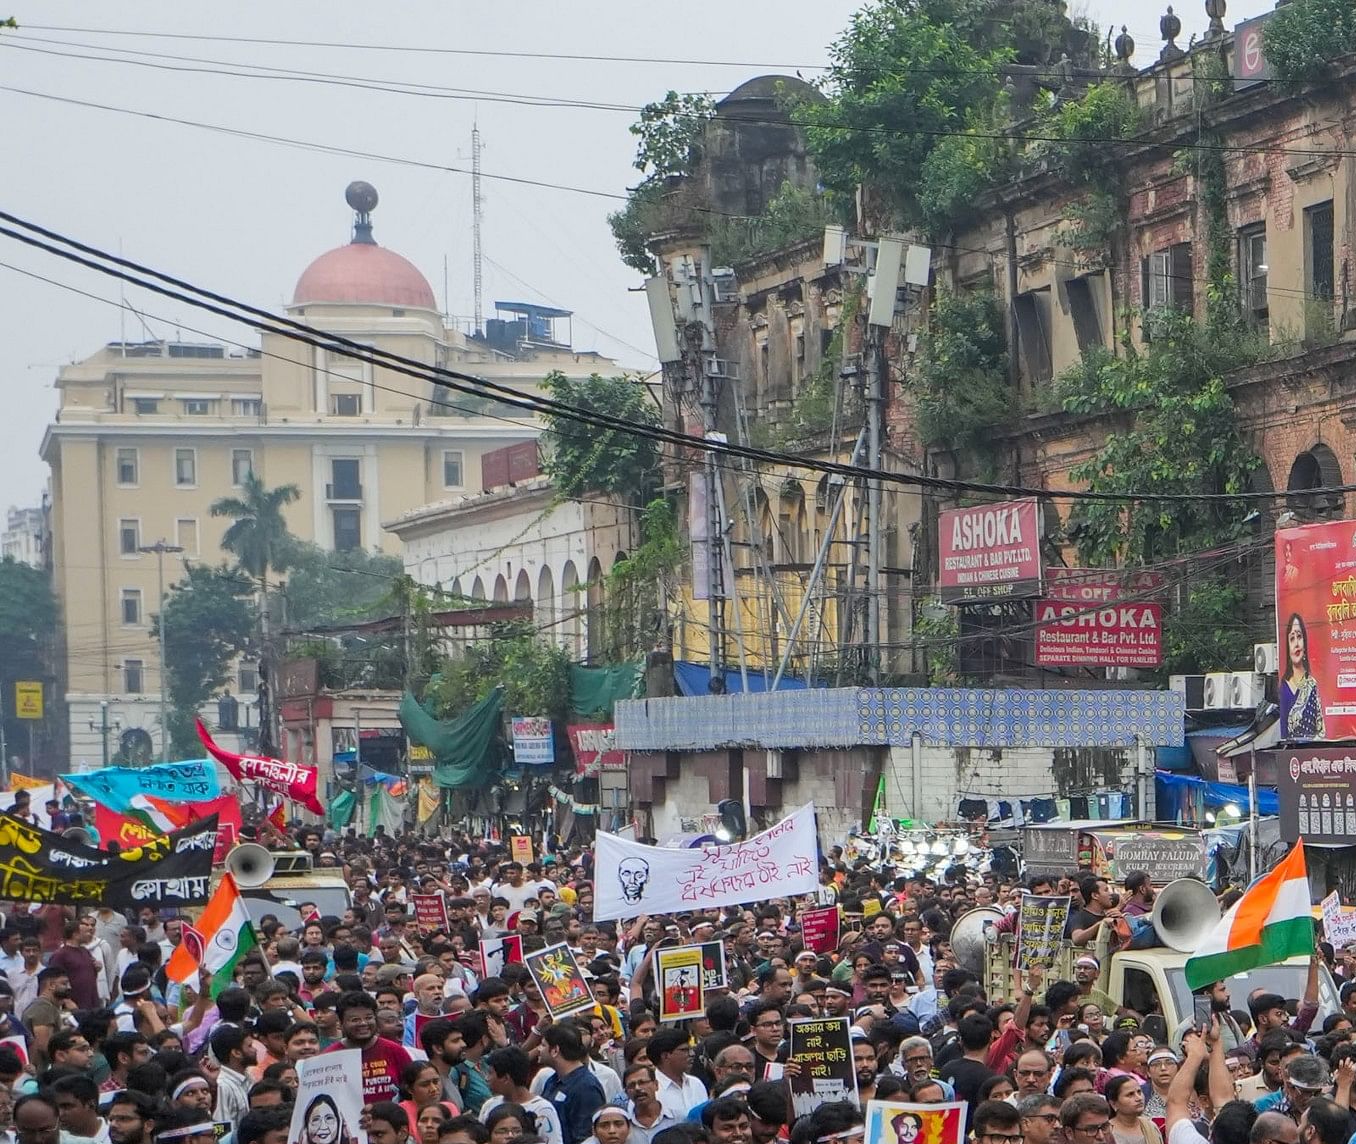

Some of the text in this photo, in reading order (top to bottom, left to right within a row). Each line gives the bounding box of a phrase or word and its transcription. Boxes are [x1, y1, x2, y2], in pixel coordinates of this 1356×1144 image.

[952, 508, 1022, 551] ASHOKA
[945, 554, 982, 571] RESTAURANT
[984, 556, 989, 566] &
[990, 552, 1003, 566] BAR
[957, 572, 973, 583] INDIAN
[978, 570, 998, 581] CHINESE
[999, 567, 1019, 578] CUISINE
[993, 584, 1014, 597] SHOP
[1040, 607, 1157, 629] ASHOKA
[1040, 630, 1157, 645] Restaurant & Bar Pvt. Ltd.
[1039, 655, 1071, 663] SEPARATE
[1099, 656, 1115, 664] HALL
[1129, 656, 1157, 664] FAMILIES
[1120, 850, 1200, 862] BOMBAY FALUDA
[131, 875, 209, 901] কোথায়
[795, 1021, 841, 1034] অভয়ার ভয়
